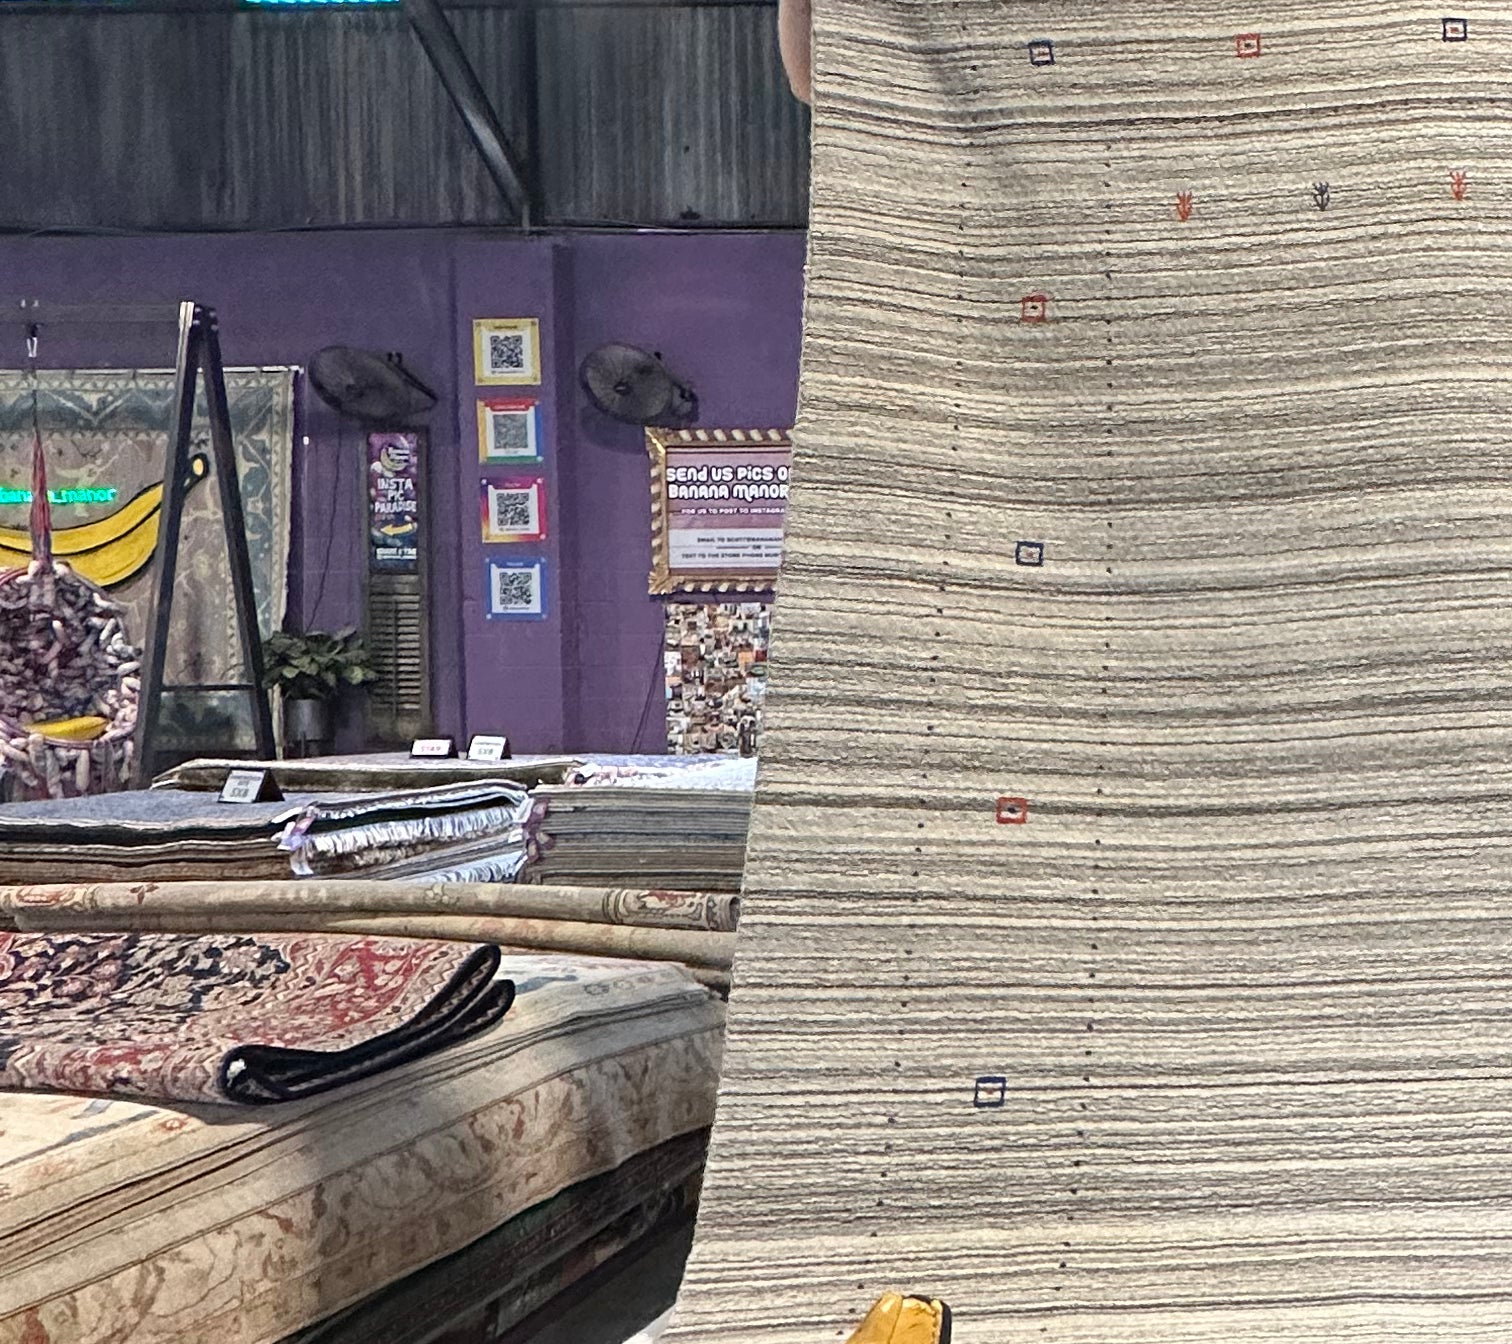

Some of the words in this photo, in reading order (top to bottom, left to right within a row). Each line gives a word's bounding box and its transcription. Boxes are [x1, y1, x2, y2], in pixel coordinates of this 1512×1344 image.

[777, 466, 791, 481] O
[377, 478, 414, 490] INSTA
[387, 489, 405, 501] PIC
[374, 500, 417, 513] PARADISE
[750, 507, 785, 515] INSTAGRA
